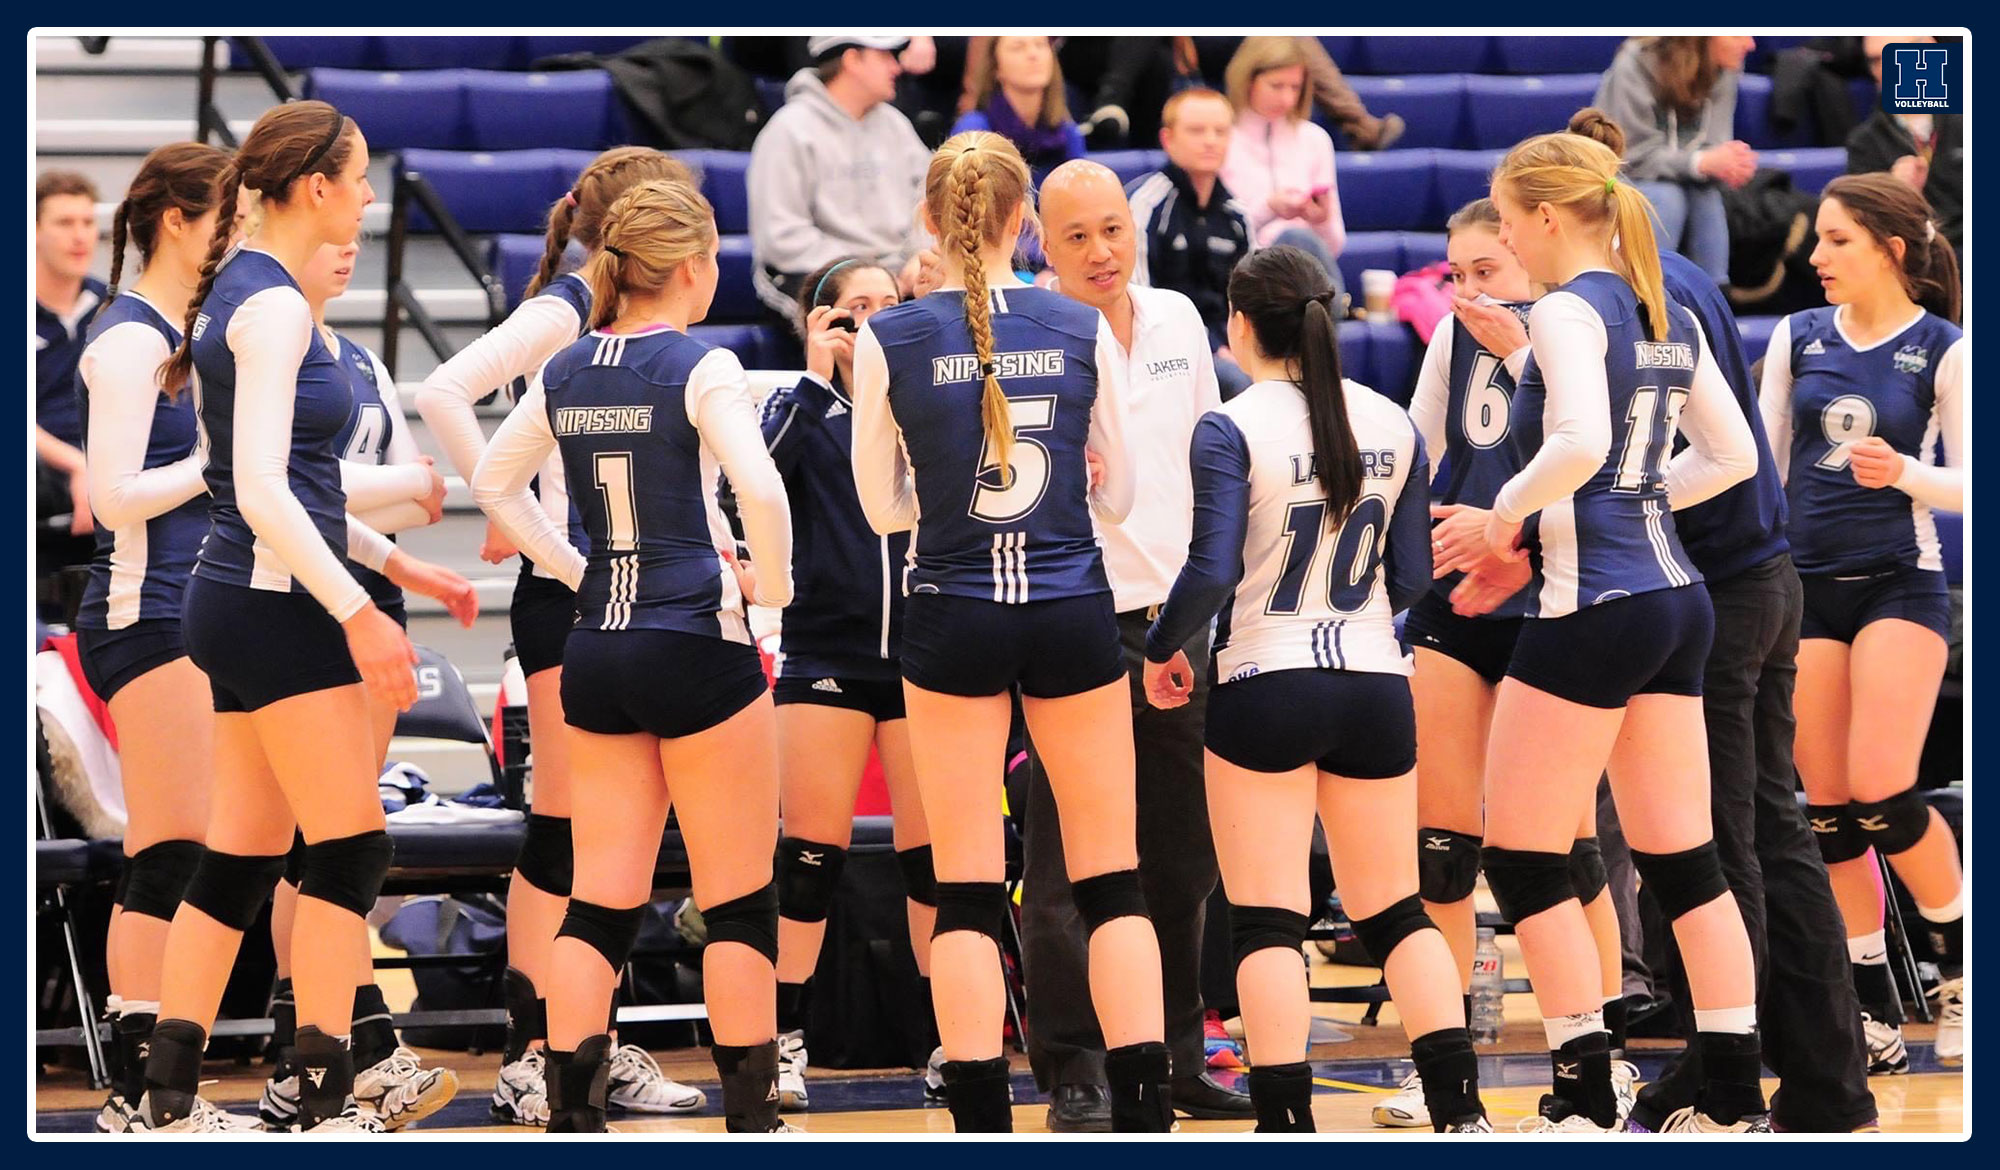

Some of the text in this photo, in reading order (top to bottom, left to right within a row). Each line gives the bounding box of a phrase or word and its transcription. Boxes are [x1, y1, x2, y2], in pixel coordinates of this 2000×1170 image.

[1146, 358, 1189, 375] LAKERS
[1462, 350, 1512, 449] 6
[342, 403, 386, 465] 4
[556, 406, 653, 436] NIPISSING
[968, 395, 1057, 523] 5
[1814, 394, 1877, 472] 9
[593, 452, 640, 551] 1
[1264, 493, 1388, 615] 10
